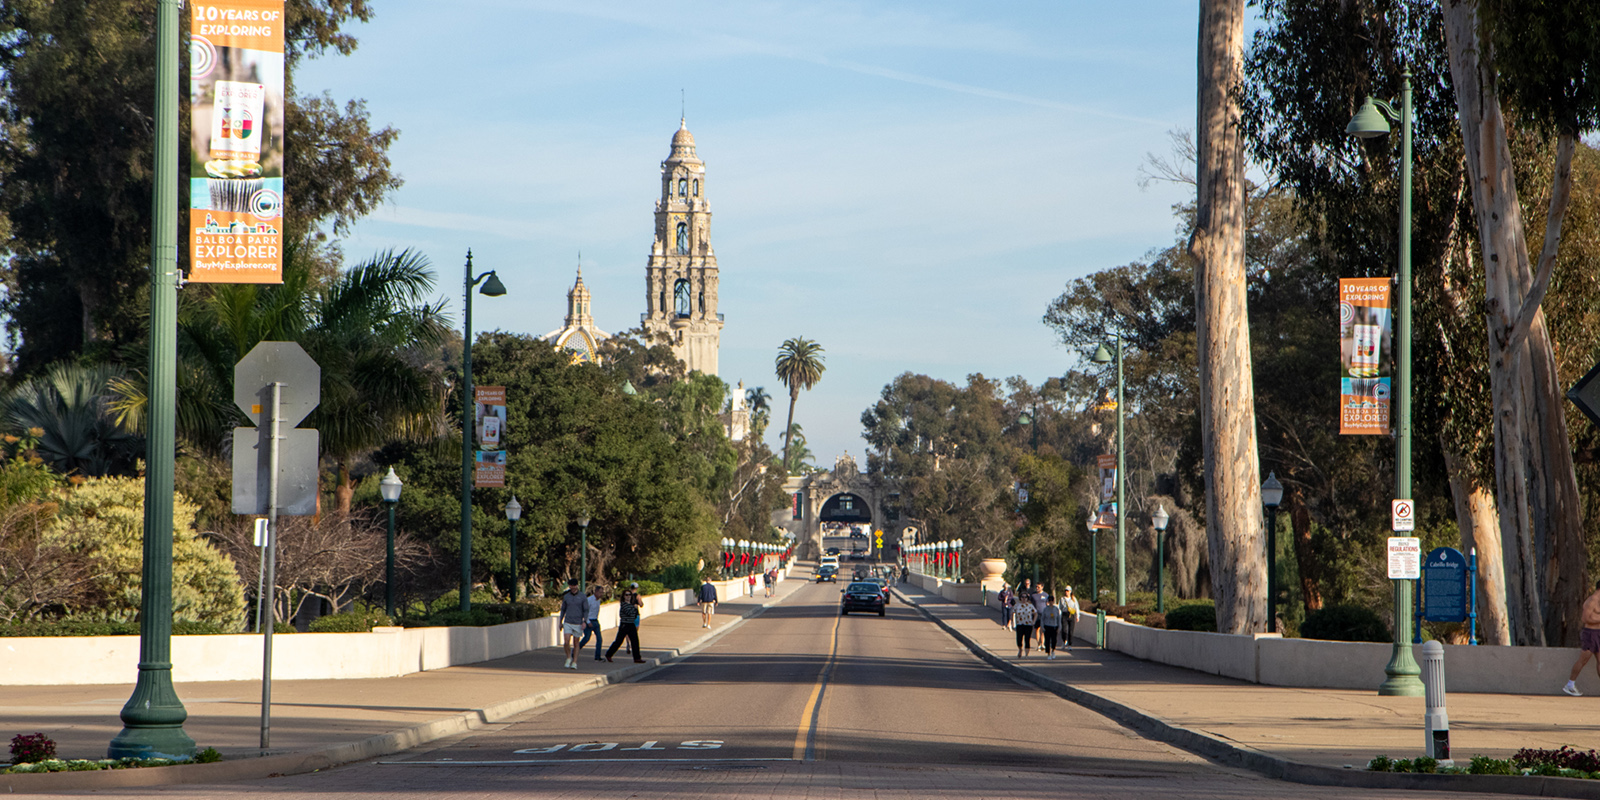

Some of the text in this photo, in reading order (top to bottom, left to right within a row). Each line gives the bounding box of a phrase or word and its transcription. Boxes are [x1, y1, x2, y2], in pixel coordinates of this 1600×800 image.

[196, 6, 280, 21] 10 YEARS OF
[200, 24, 272, 37] EXPLORING
[195, 236, 278, 245] BALBOA PARK
[195, 245, 278, 258] EXPLORER
[195, 260, 277, 271] BuyMyExplorer.org
[1343, 284, 1355, 293] 10
[1345, 293, 1385, 301] EXPLORING
[1343, 413, 1388, 422] EXPLORER
[1445, 561, 1459, 569] Bridge
[512, 740, 725, 754] STOP
